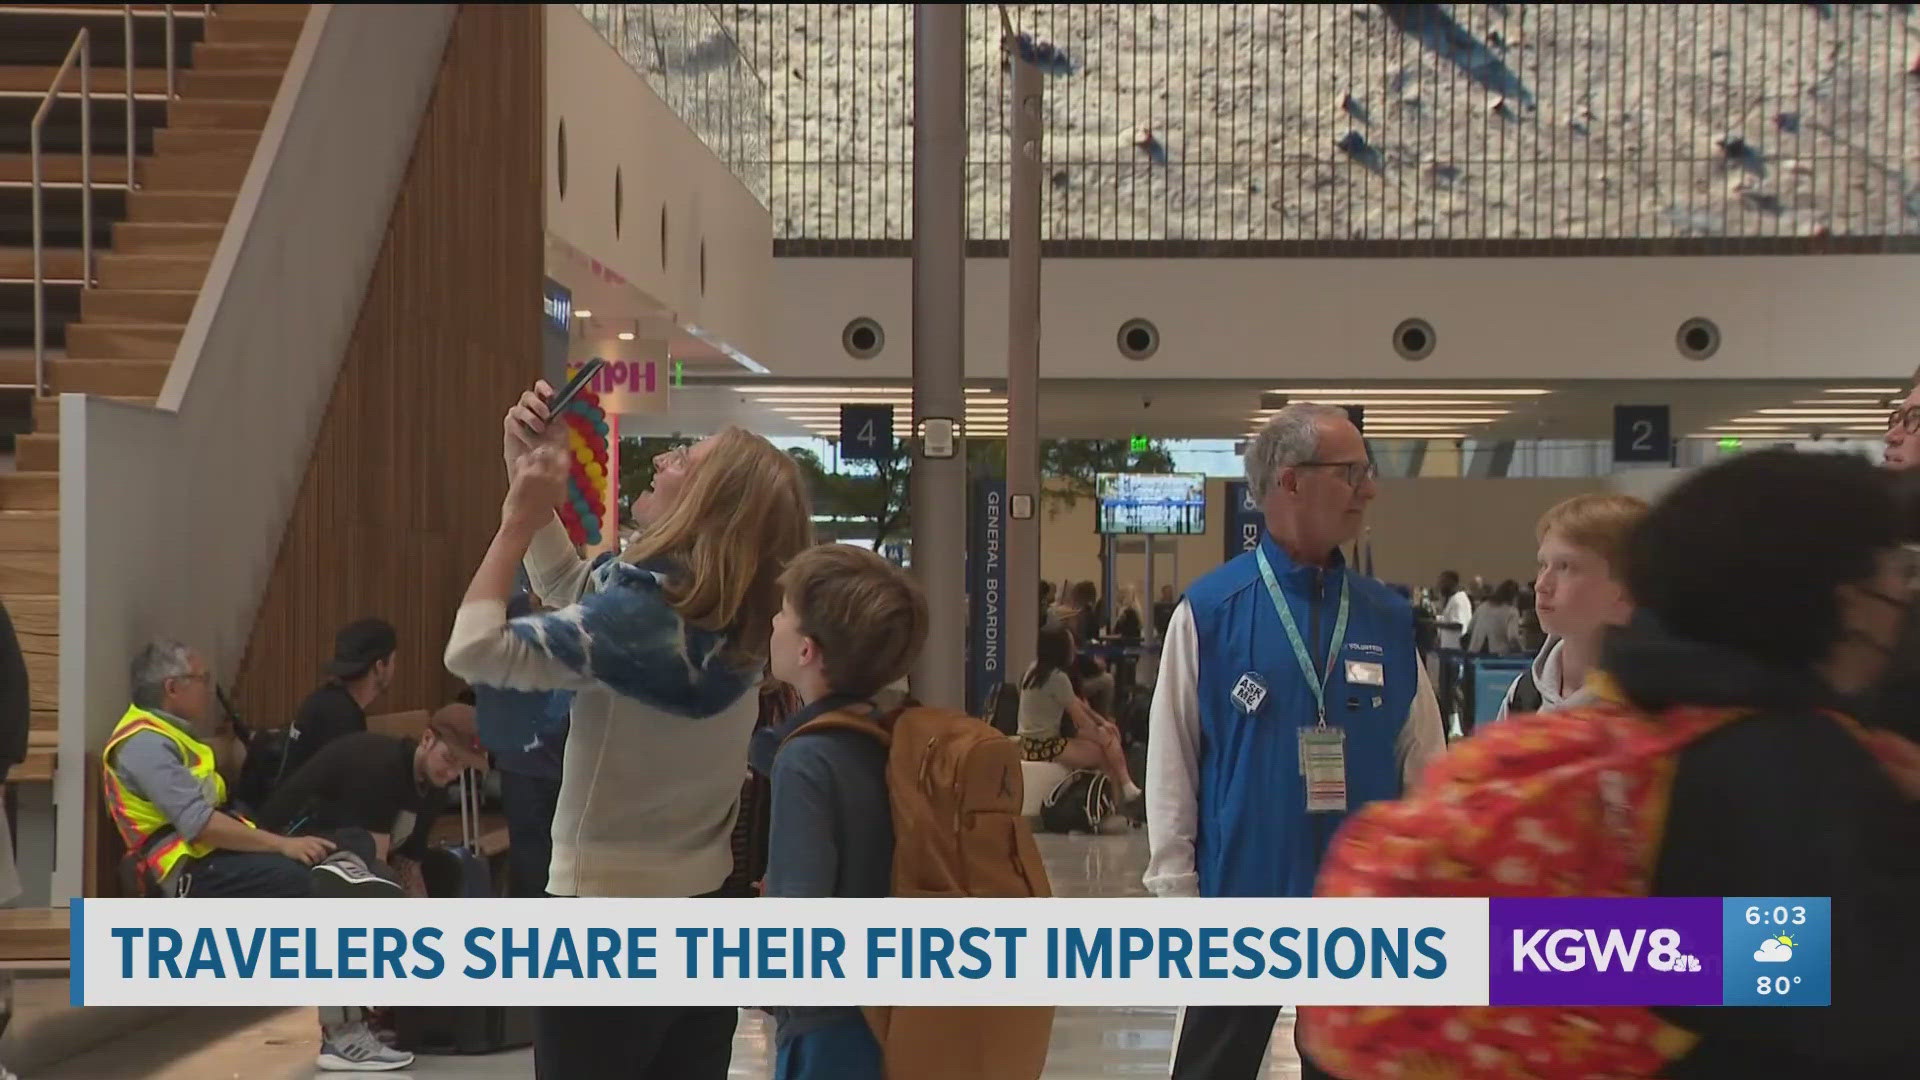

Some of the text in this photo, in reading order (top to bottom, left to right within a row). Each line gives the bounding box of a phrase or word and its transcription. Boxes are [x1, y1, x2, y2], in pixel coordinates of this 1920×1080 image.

[857, 418, 877, 449] 4
[1631, 420, 1653, 450] 2
[985, 491, 1000, 671] GENERAL BOARDING
[1236, 687, 1256, 706] ME
[1239, 678, 1264, 700] ASK
